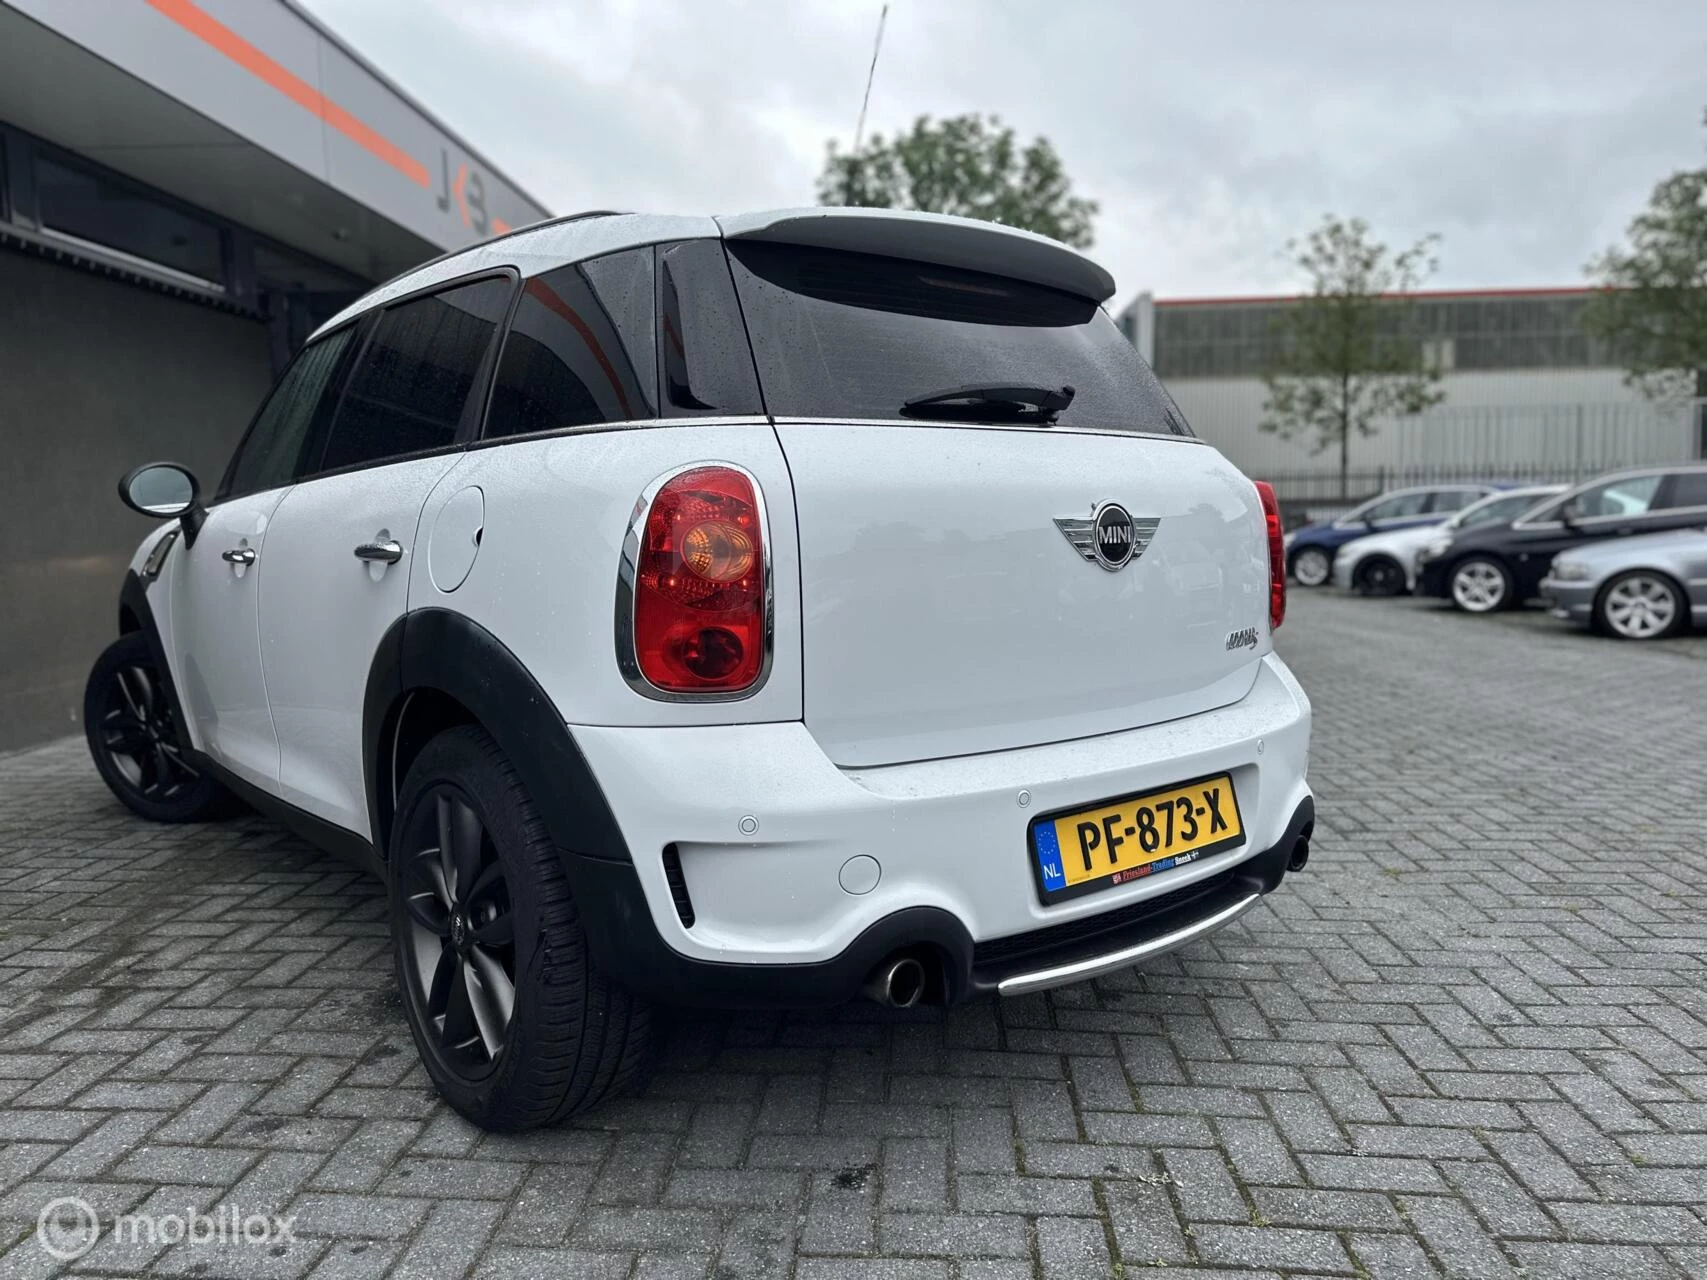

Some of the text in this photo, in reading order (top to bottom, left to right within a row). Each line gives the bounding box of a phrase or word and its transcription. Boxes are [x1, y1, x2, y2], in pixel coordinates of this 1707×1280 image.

[1098, 526, 1131, 545] MINI
[1077, 788, 1228, 871] PF-873-X
[1043, 862, 1062, 881] NL
